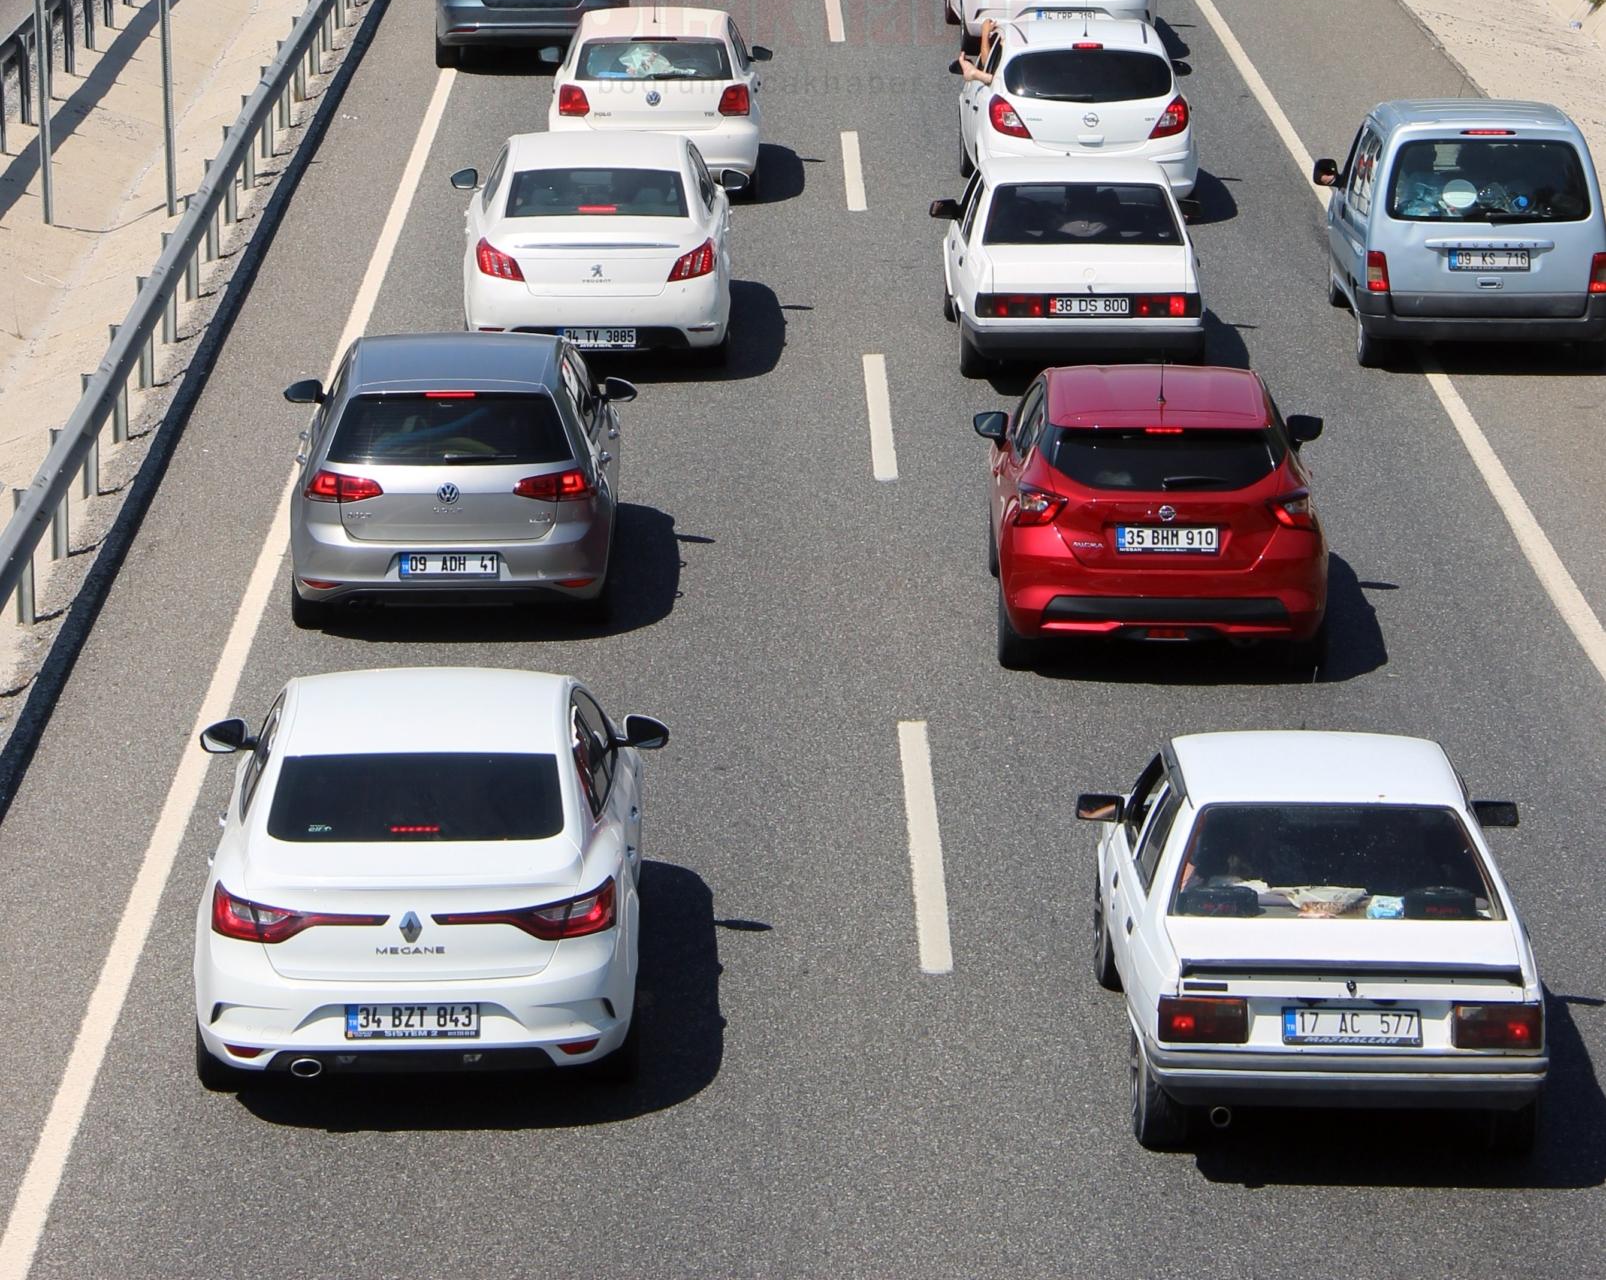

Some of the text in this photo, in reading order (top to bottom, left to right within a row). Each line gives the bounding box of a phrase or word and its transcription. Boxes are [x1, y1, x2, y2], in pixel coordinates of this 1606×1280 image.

[1457, 253, 1527, 266] 09 KS 716
[1057, 299, 1128, 312] 38 DS 800
[565, 330, 634, 343] 34 TV 3885
[1127, 530, 1145, 546] 35
[1152, 530, 1179, 546] BHM
[1186, 531, 1214, 546] 910
[410, 556, 427, 572] 09
[441, 556, 466, 572] ADH
[480, 556, 495, 572] 41
[376, 946, 445, 955] MEGANE
[359, 1006, 382, 1028] 34
[392, 1006, 428, 1028] BZT
[436, 1006, 472, 1028] 843
[1300, 1012, 1319, 1033] 17
[1339, 1012, 1360, 1034] AC
[1380, 1014, 1414, 1035] 577
